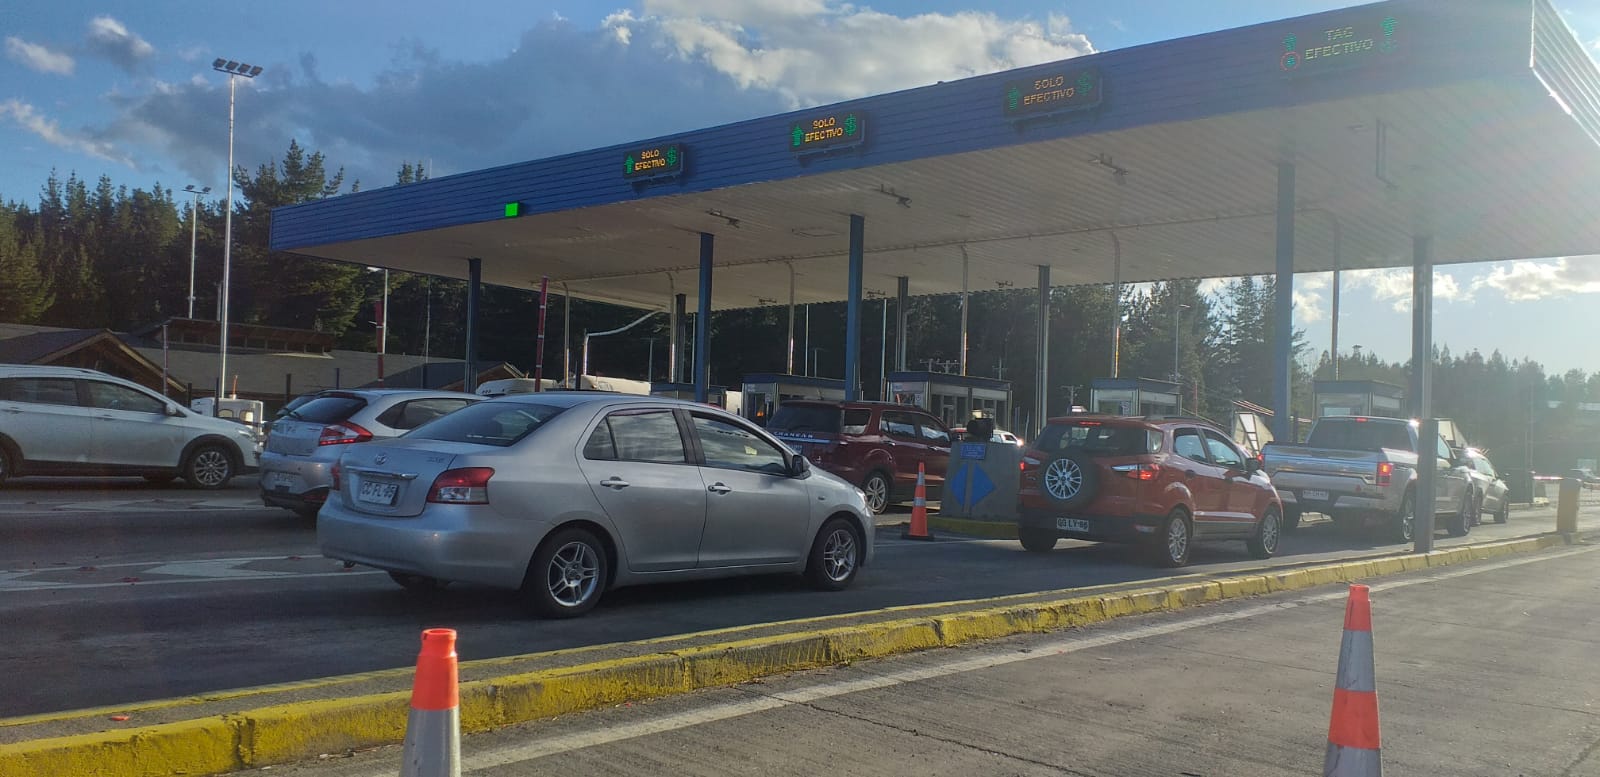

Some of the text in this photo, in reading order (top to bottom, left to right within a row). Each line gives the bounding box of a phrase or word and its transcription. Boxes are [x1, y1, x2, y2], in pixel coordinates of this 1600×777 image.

[1325, 26, 1353, 41] TAG
[1305, 38, 1374, 60] EFECTIVO
[1034, 75, 1064, 90] SOLO
[1023, 87, 1075, 105] EFECTIVO
[812, 117, 836, 129] SOLO
[804, 127, 844, 142] EFECTIVO
[641, 149, 660, 159] SOLO
[634, 158, 666, 171] EFECTIVO
